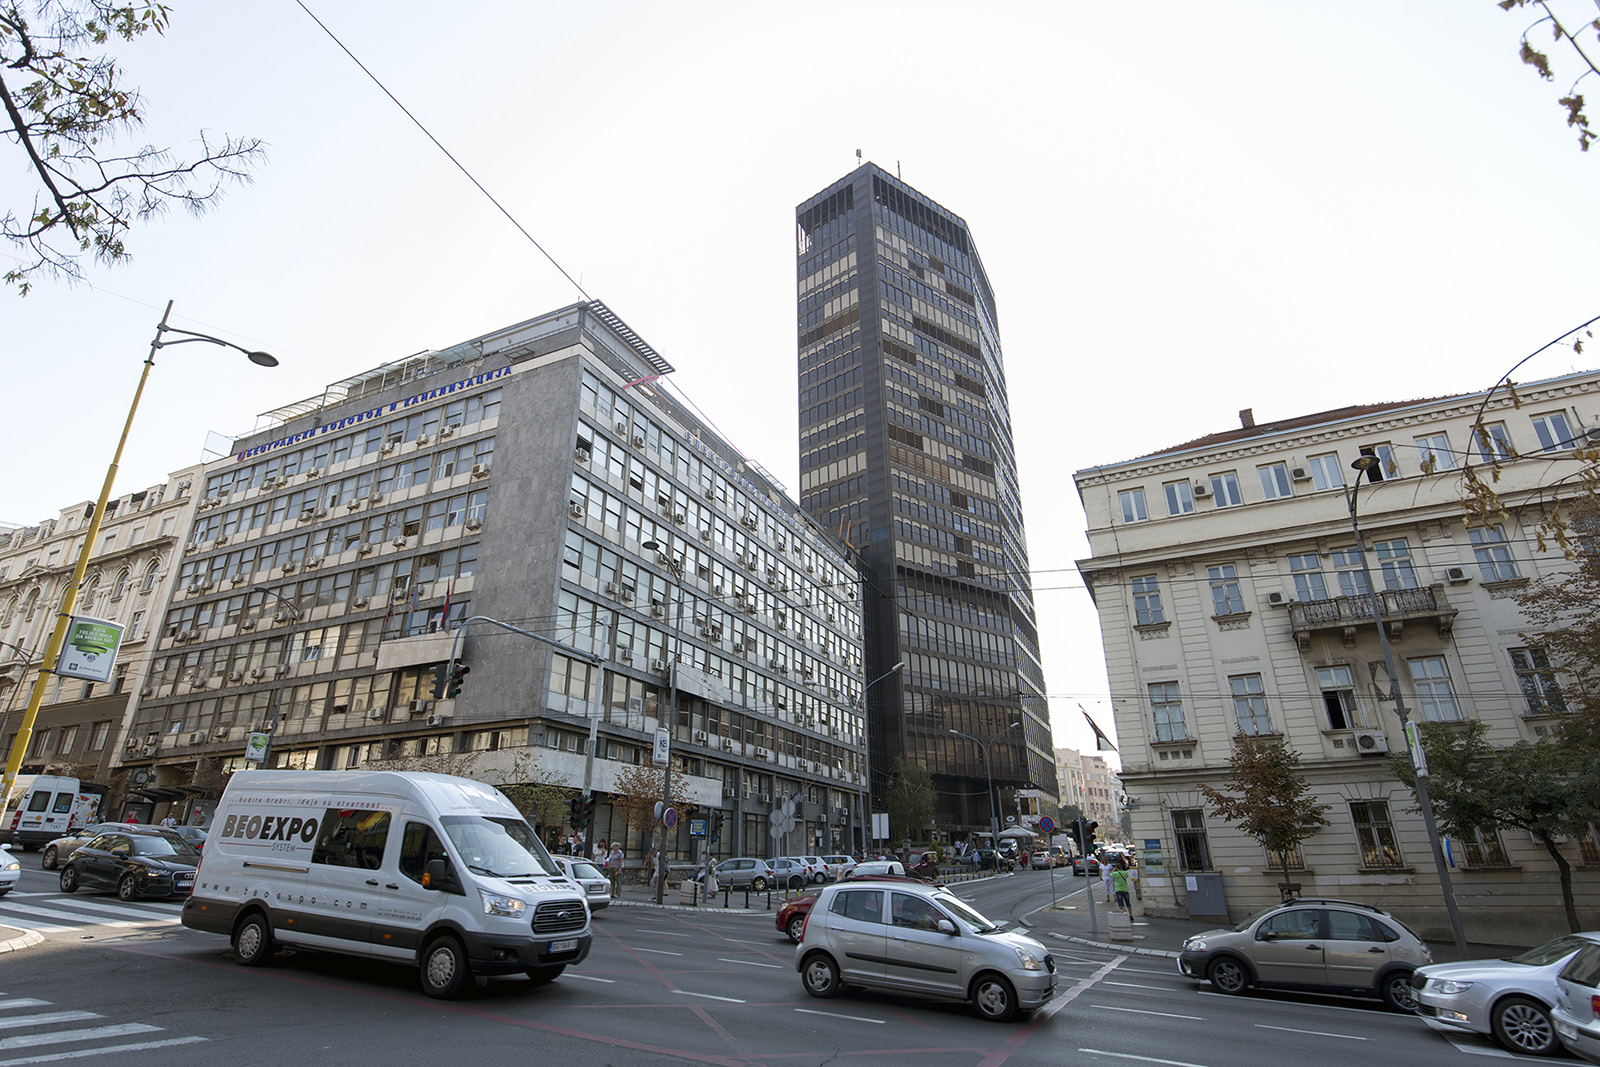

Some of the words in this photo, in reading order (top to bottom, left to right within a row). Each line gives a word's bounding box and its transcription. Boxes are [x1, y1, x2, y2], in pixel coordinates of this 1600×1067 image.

[246, 428, 316, 458] БЕОГРАДСКИ
[321, 406, 383, 433] ВОДОВОД
[389, 402, 397, 412] И
[404, 366, 512, 407] КАНАЛИЗАЦИЈА
[297, 798, 318, 806] ideje
[221, 814, 319, 843] BEOEXPO
[271, 843, 296, 852] SYSTEM
